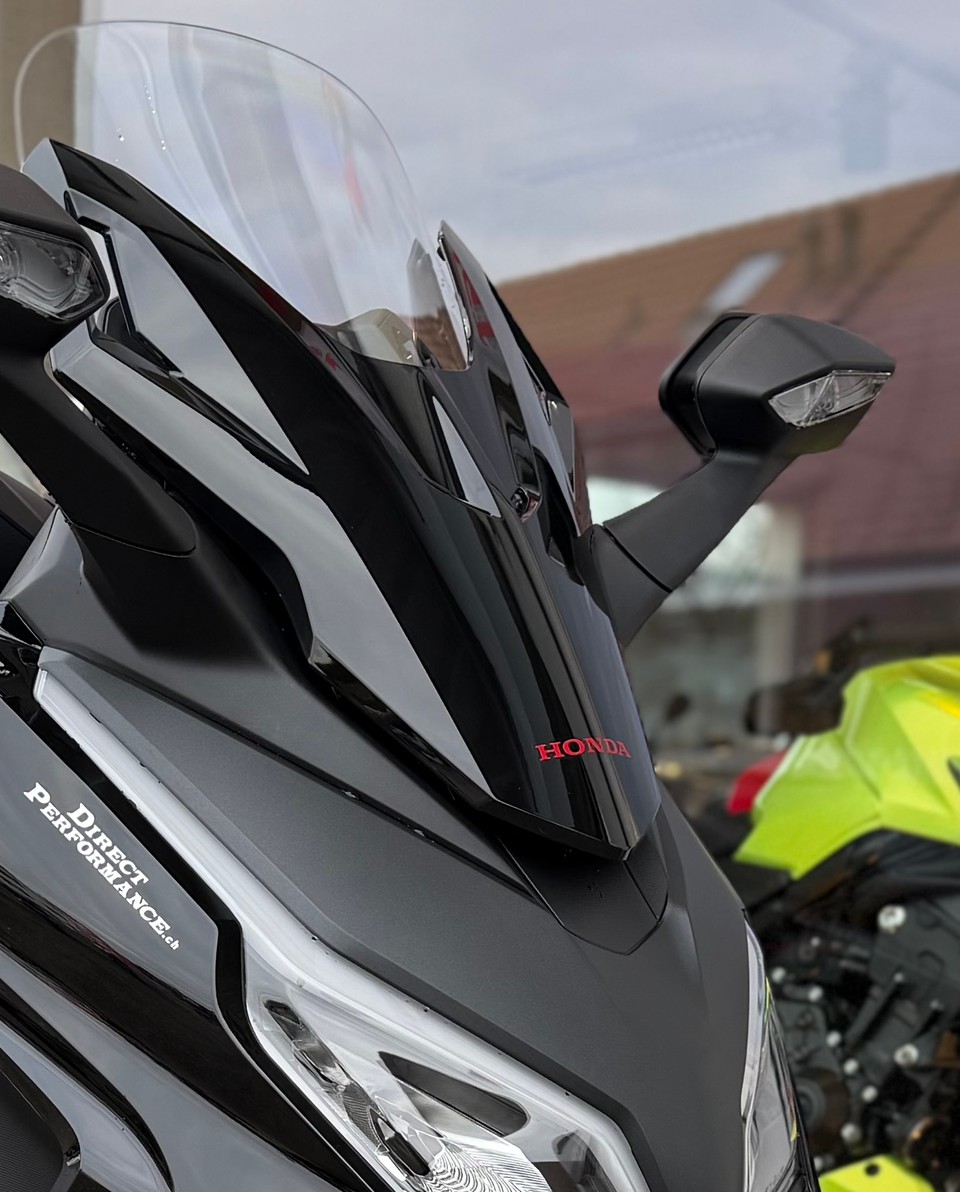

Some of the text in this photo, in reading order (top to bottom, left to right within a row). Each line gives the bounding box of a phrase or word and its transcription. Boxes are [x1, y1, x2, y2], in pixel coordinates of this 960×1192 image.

[535, 737, 631, 761] HONDA
[22, 781, 181, 951] PERFORMANCE.ch
[66, 802, 150, 886] DIRECT
